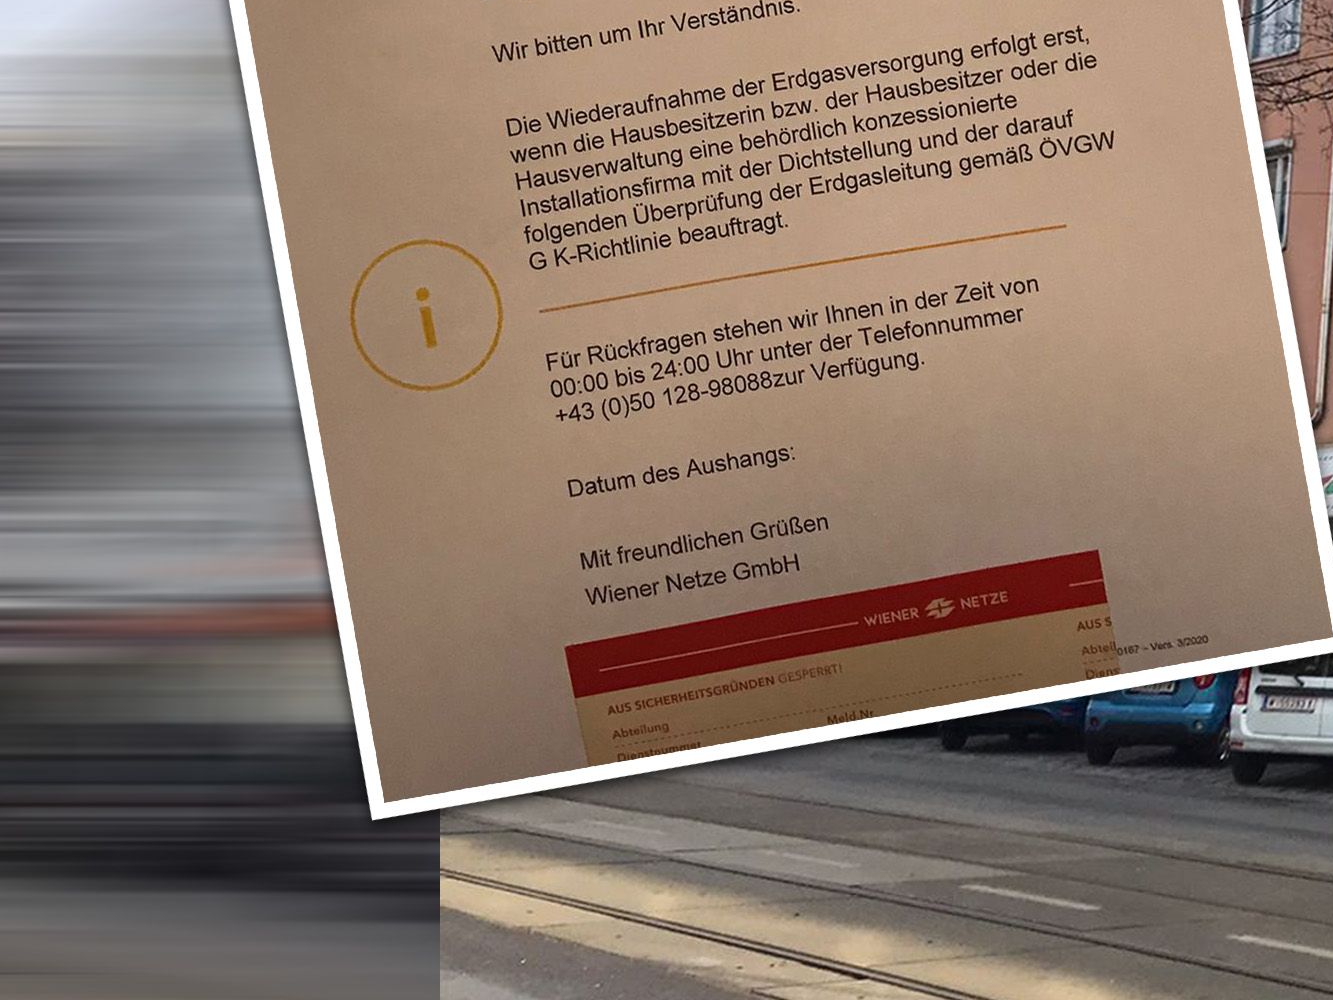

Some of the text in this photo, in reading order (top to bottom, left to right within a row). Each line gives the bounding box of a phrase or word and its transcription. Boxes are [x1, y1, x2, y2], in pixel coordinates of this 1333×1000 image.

[491, 41, 528, 63] Wir
[534, 34, 592, 56] bitten
[599, 27, 631, 45] um
[638, 19, 665, 38] Ihr
[506, 25, 1089, 137] Die Wiederaufnahme der Erdgasversorgung erfolgt erst,
[510, 52, 1097, 163] wenn die Hausbesitzerin bzw. der Hausbesitzer oder die
[515, 93, 1017, 190] Hausverwaltung eine behördlich konzessionierte
[520, 109, 1073, 217] Installationsfirma mit der Dichtstellung und der darauf
[524, 130, 1114, 244] folgenden Überprüfung der Erdgasleitung gemäß ÖVGW
[529, 211, 788, 270] G K-Richtlinie beauftragt.
[546, 279, 1039, 371] Für Rückfragen stehen wir Ihnen in der Zeit von
[550, 308, 1024, 398] 00:00 bis 24:00 Uhr unter der Telefonnummer
[555, 402, 594, 422] +43
[602, 391, 655, 421] (0)50
[810, 352, 924, 381] Verfügung.
[567, 447, 795, 497] Datum des Aushangs:
[580, 516, 829, 570] Mit freundlichen Grüßen
[585, 553, 800, 605] Wiener Netze GmbH
[864, 591, 1009, 627] WIENER NETZE
[1076, 618, 1102, 632] AUS
[607, 663, 843, 716] AUS SICHERHEITSGRÜNDEN GESPERRT!
[612, 723, 670, 739] Abteilung
